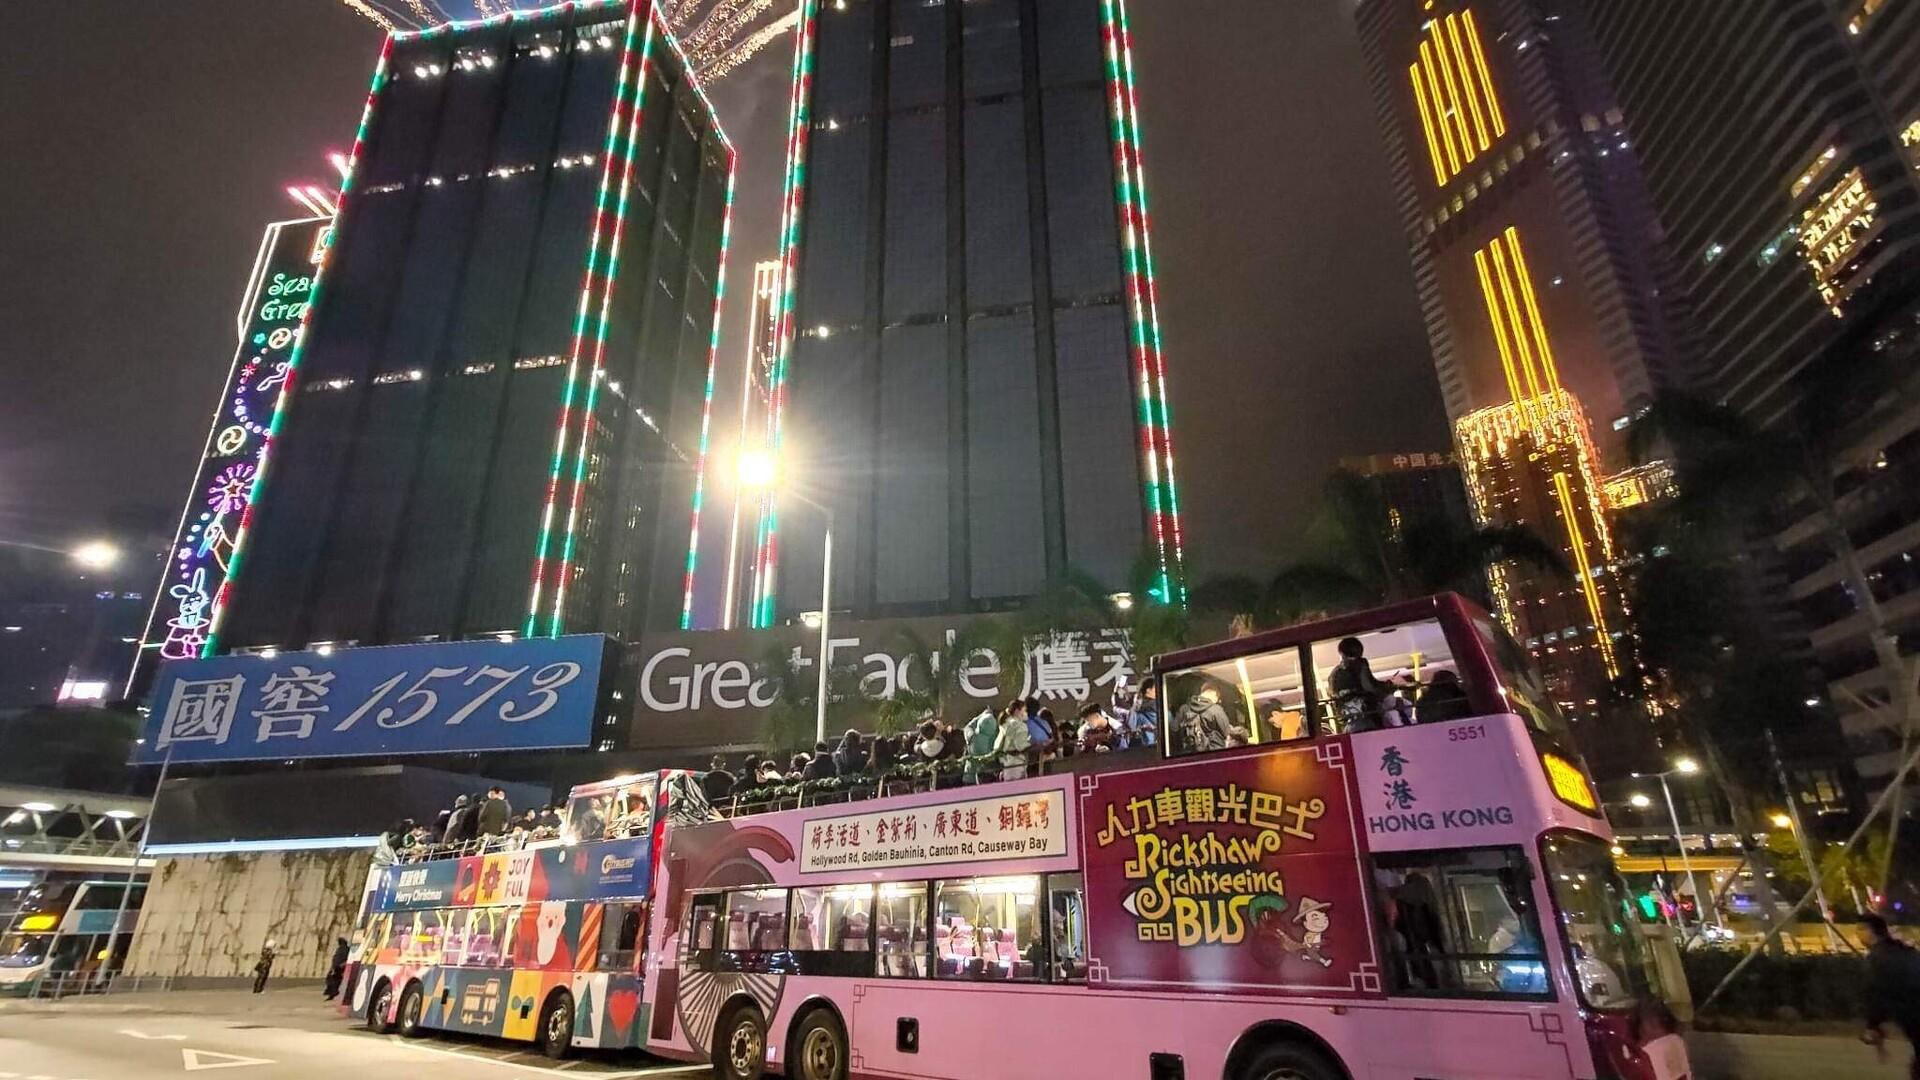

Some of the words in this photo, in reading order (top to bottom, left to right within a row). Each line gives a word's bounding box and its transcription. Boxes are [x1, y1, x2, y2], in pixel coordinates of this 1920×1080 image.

[268, 273, 314, 296] Sea
[826, 629, 1001, 702] Eae
[154, 666, 336, 751] 國窖
[332, 662, 581, 733] 1573
[1448, 725, 1486, 742] 5551
[1379, 746, 1416, 810] 香港
[1097, 784, 1325, 847] 人力車觀光巴士
[1369, 813, 1435, 833] HONG
[1443, 806, 1513, 829] KONG
[508, 857, 530, 875] JOY
[811, 853, 847, 867] Hollywood
[848, 853, 859, 864] Rd,
[862, 850, 887, 862] Golden
[890, 845, 927, 859] Bauhinia,
[929, 844, 958, 857] Canton
[961, 842, 975, 856] Rd,
[978, 839, 1026, 853] Causeway
[1029, 837, 1048, 851] Bay
[1125, 829, 1281, 878] Rickshaw
[394, 890, 412, 905] Merry
[412, 889, 443, 901] Christmas
[505, 880, 523, 897] FUL
[1136, 869, 1284, 920] Sightseeing
[1172, 894, 1256, 946] BUS
